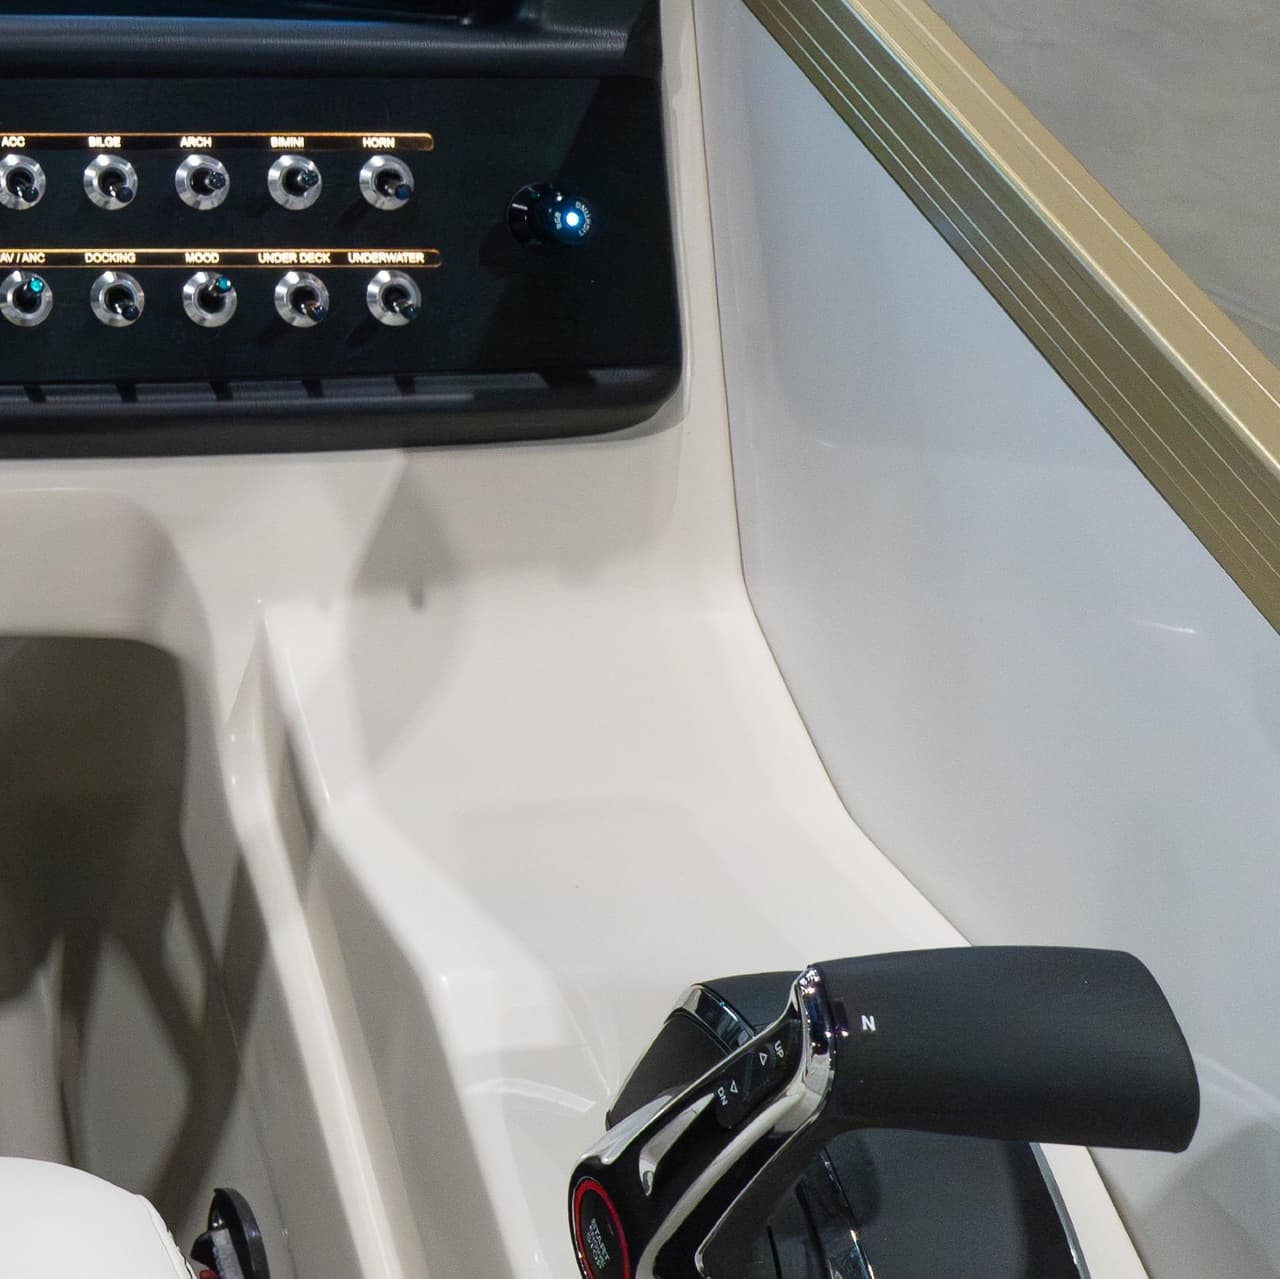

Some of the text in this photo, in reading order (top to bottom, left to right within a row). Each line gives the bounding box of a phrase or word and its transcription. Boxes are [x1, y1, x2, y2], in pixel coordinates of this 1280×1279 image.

[1, 136, 25, 147] ACC
[88, 136, 122, 148] BILGE
[180, 136, 212, 148] ARCH
[270, 137, 305, 148] BIMINI
[362, 137, 395, 148] HORN
[21, 253, 45, 263] ANC
[84, 253, 136, 263] DOCKING
[185, 252, 220, 263] MOOD
[257, 252, 331, 264] UNDER DECK
[347, 252, 425, 264] UNDERWATER
[861, 1015, 876, 1032] N
[774, 1040, 785, 1058] UP
